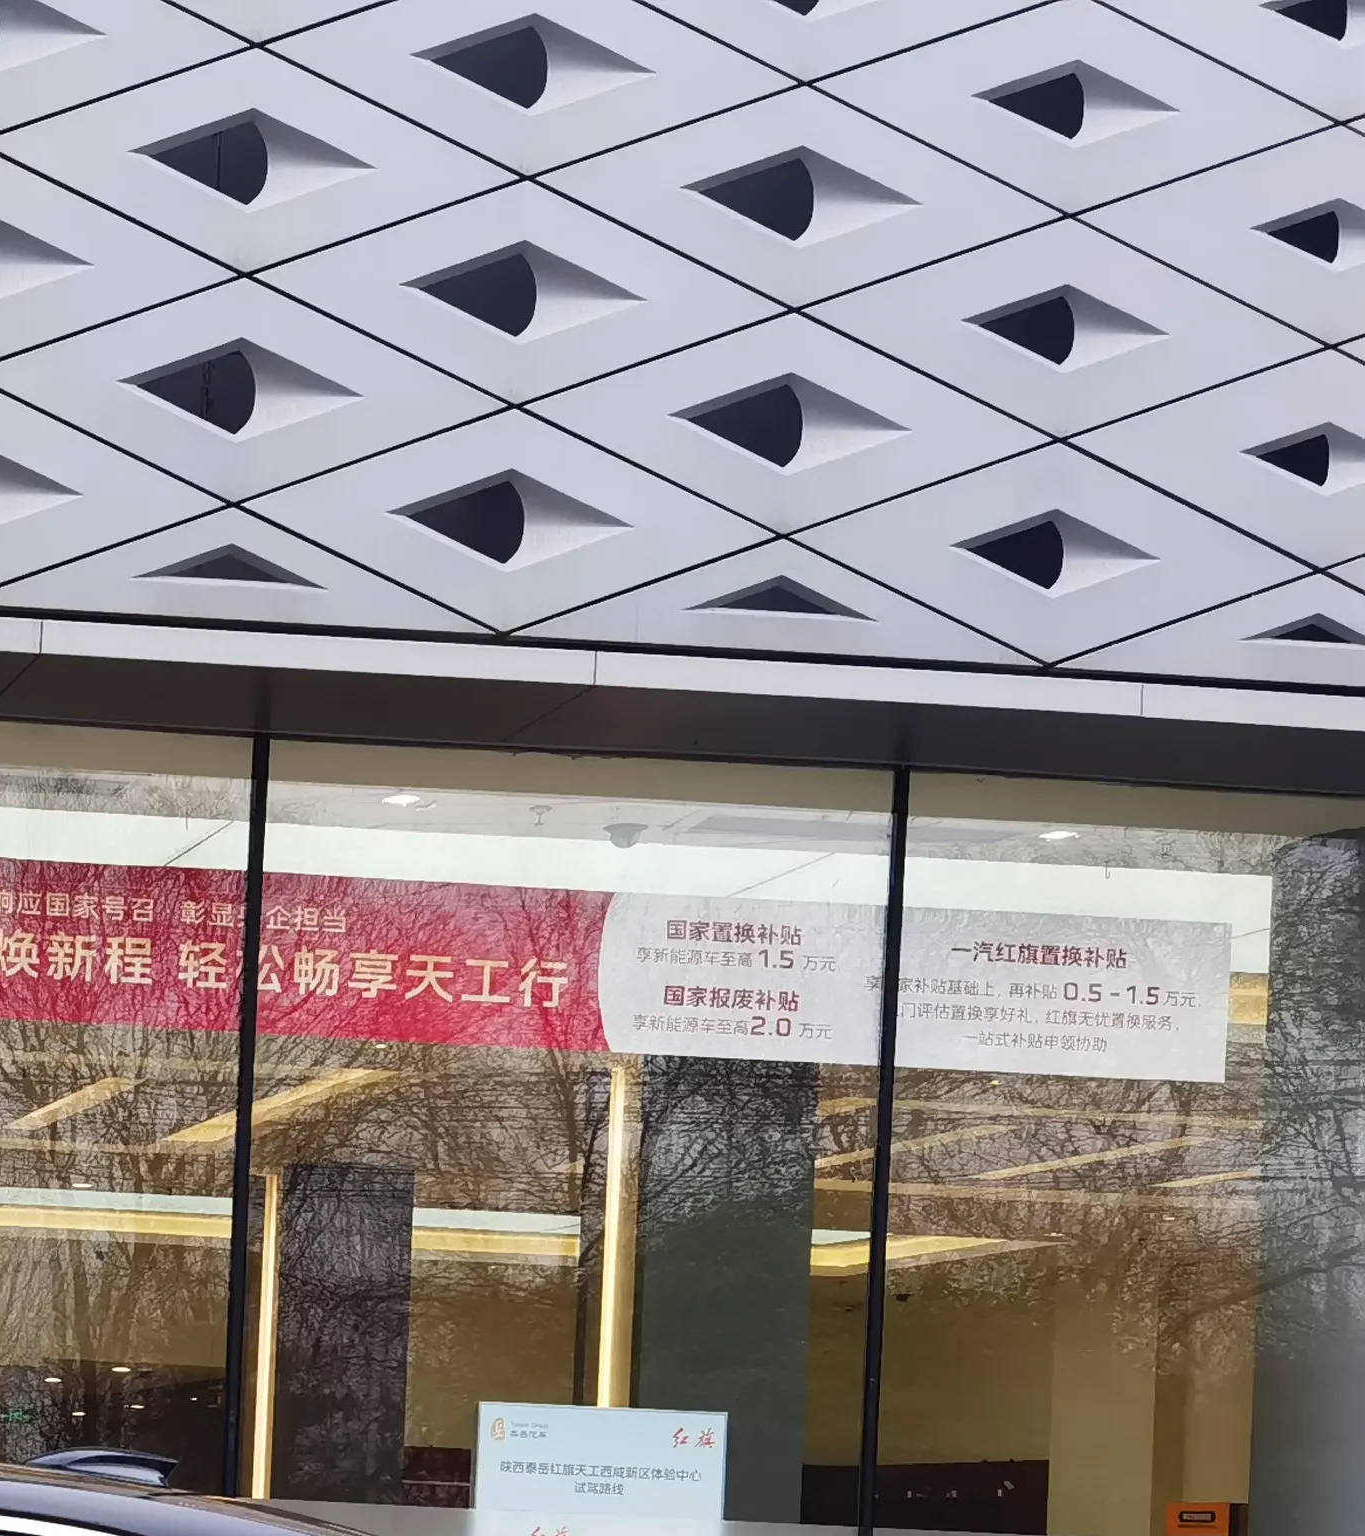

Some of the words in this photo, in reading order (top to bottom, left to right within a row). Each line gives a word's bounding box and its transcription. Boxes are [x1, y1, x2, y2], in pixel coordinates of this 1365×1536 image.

[666, 919, 803, 947] 国家置换补贴
[951, 940, 1128, 969] 一汽红旗置换补贴
[662, 984, 801, 1012] 国家报废补贴
[672, 1427, 715, 1448] 红旗
